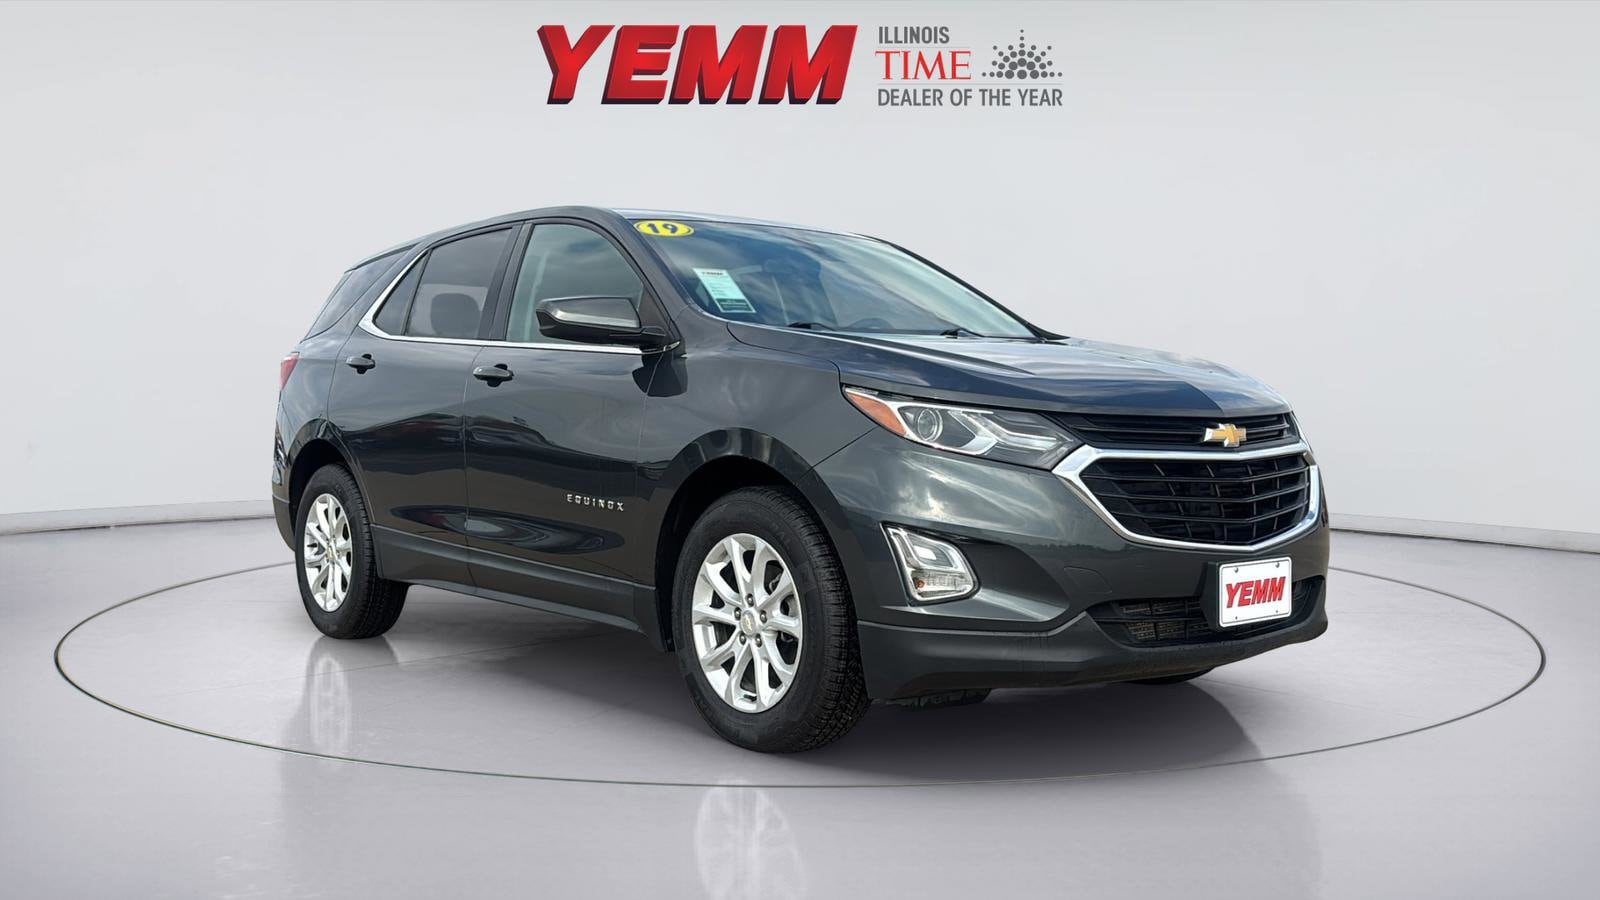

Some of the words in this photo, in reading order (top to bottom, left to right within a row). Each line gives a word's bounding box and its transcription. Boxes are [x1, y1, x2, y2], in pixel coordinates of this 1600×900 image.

[647, 222, 679, 234] 19
[566, 493, 624, 511] EQUINOX
[1225, 576, 1286, 608] YEMM
